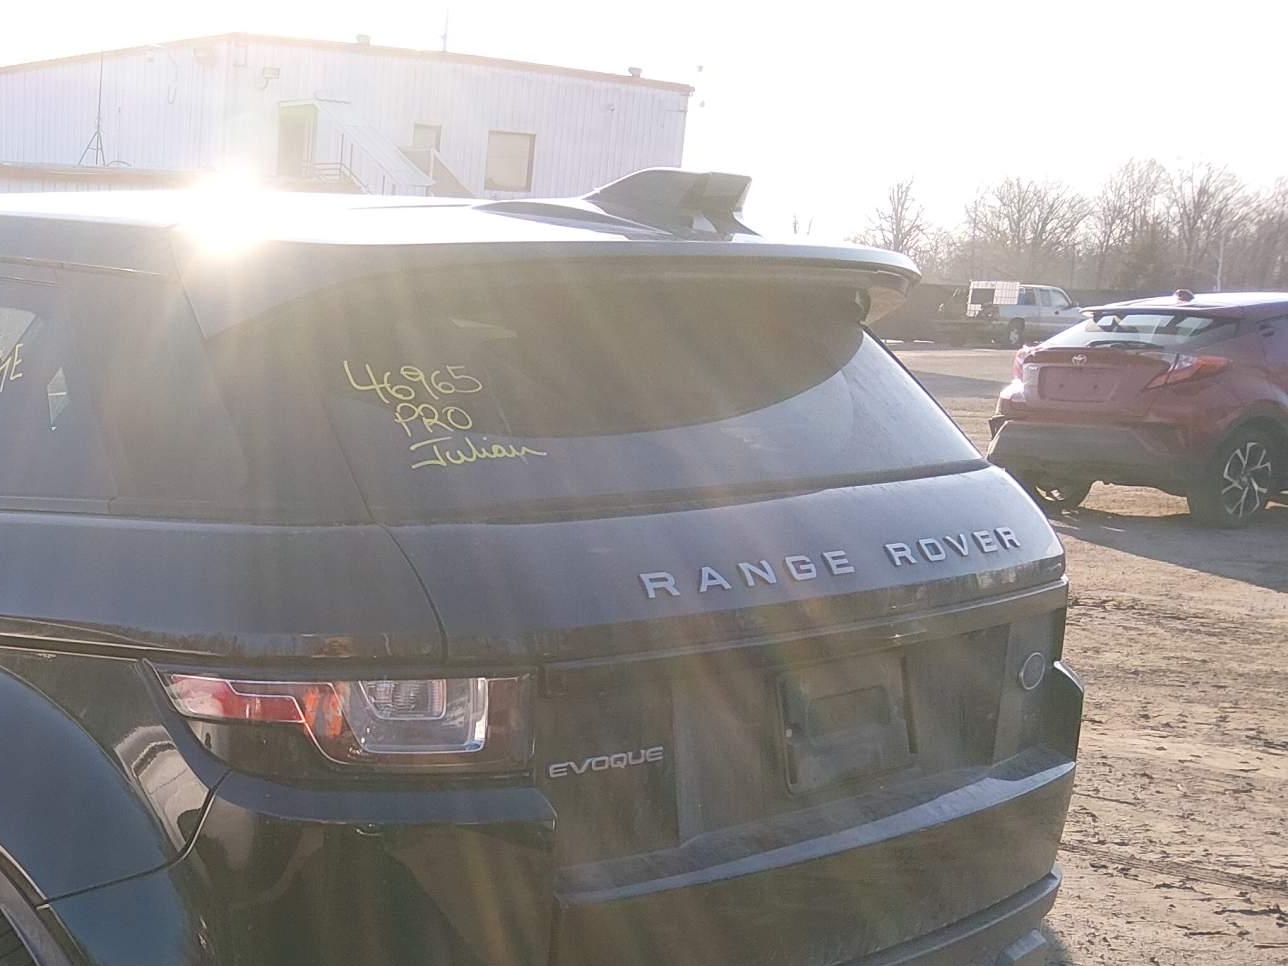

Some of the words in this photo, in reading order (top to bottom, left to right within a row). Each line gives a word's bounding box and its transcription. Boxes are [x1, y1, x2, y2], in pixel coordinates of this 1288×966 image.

[342, 359, 483, 404] 46965
[393, 402, 473, 437] PRO
[639, 549, 856, 599] RANGE
[884, 526, 1021, 567] ROVER
[548, 746, 664, 778] EVOQUE
